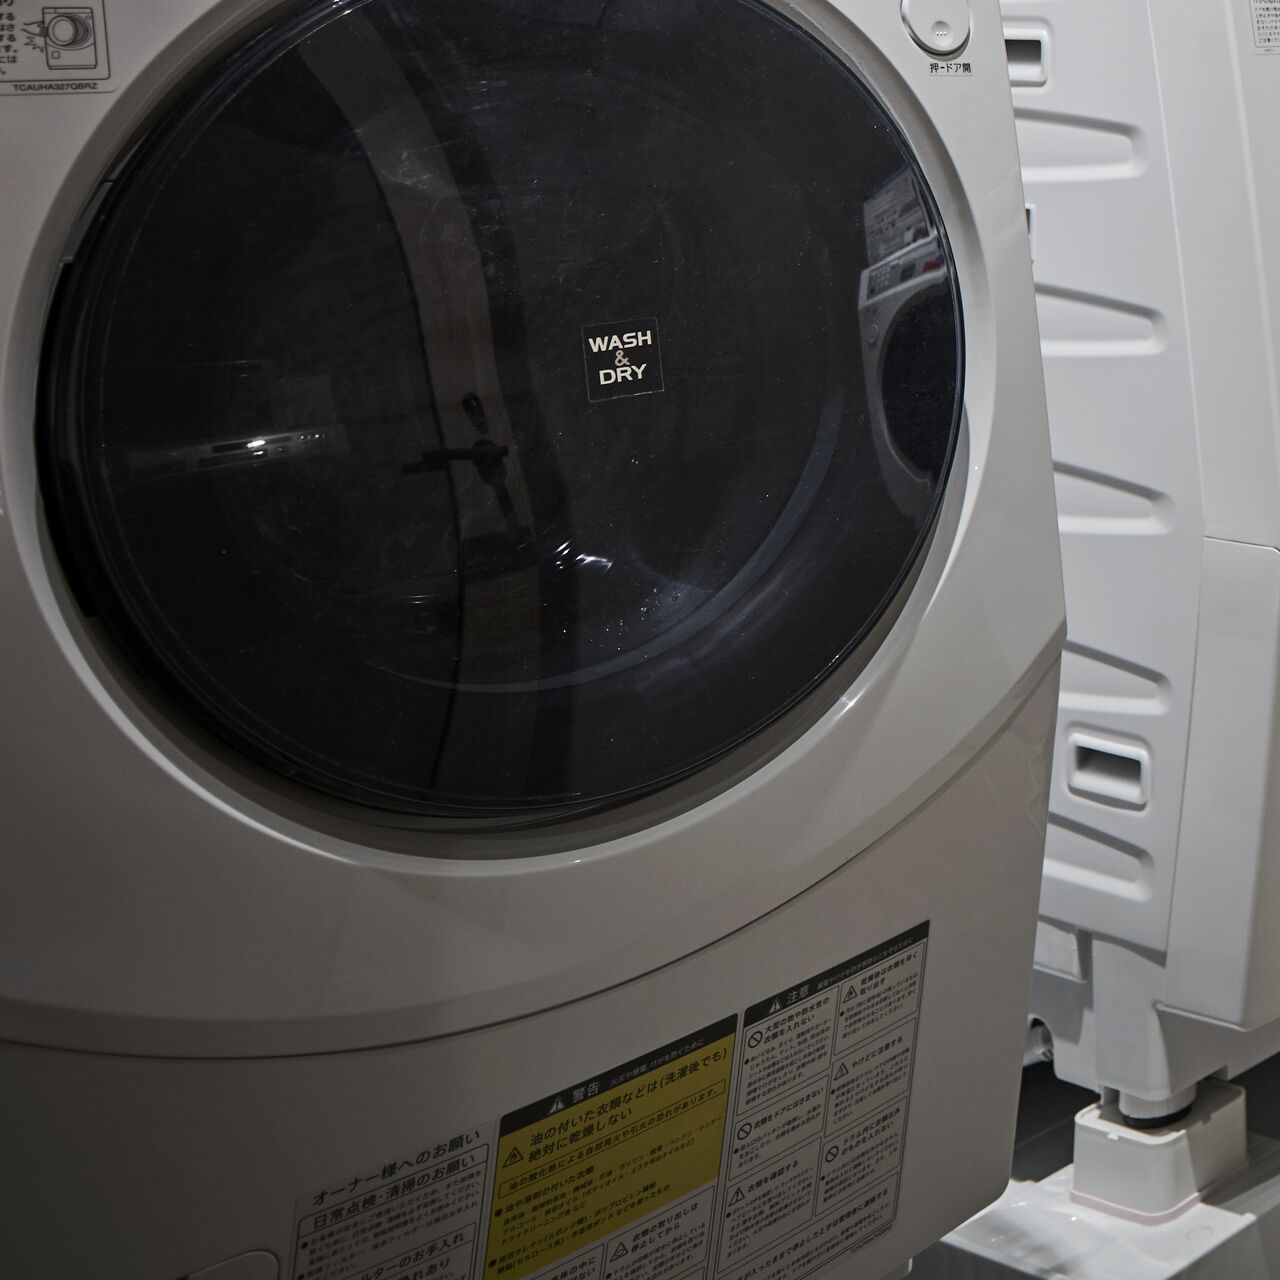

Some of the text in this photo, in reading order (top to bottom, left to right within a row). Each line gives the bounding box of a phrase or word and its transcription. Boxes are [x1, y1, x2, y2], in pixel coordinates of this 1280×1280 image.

[588, 330, 652, 352] WASH
[615, 350, 630, 366] &
[599, 364, 647, 385] DRY
[571, 1082, 601, 1104] 警告
